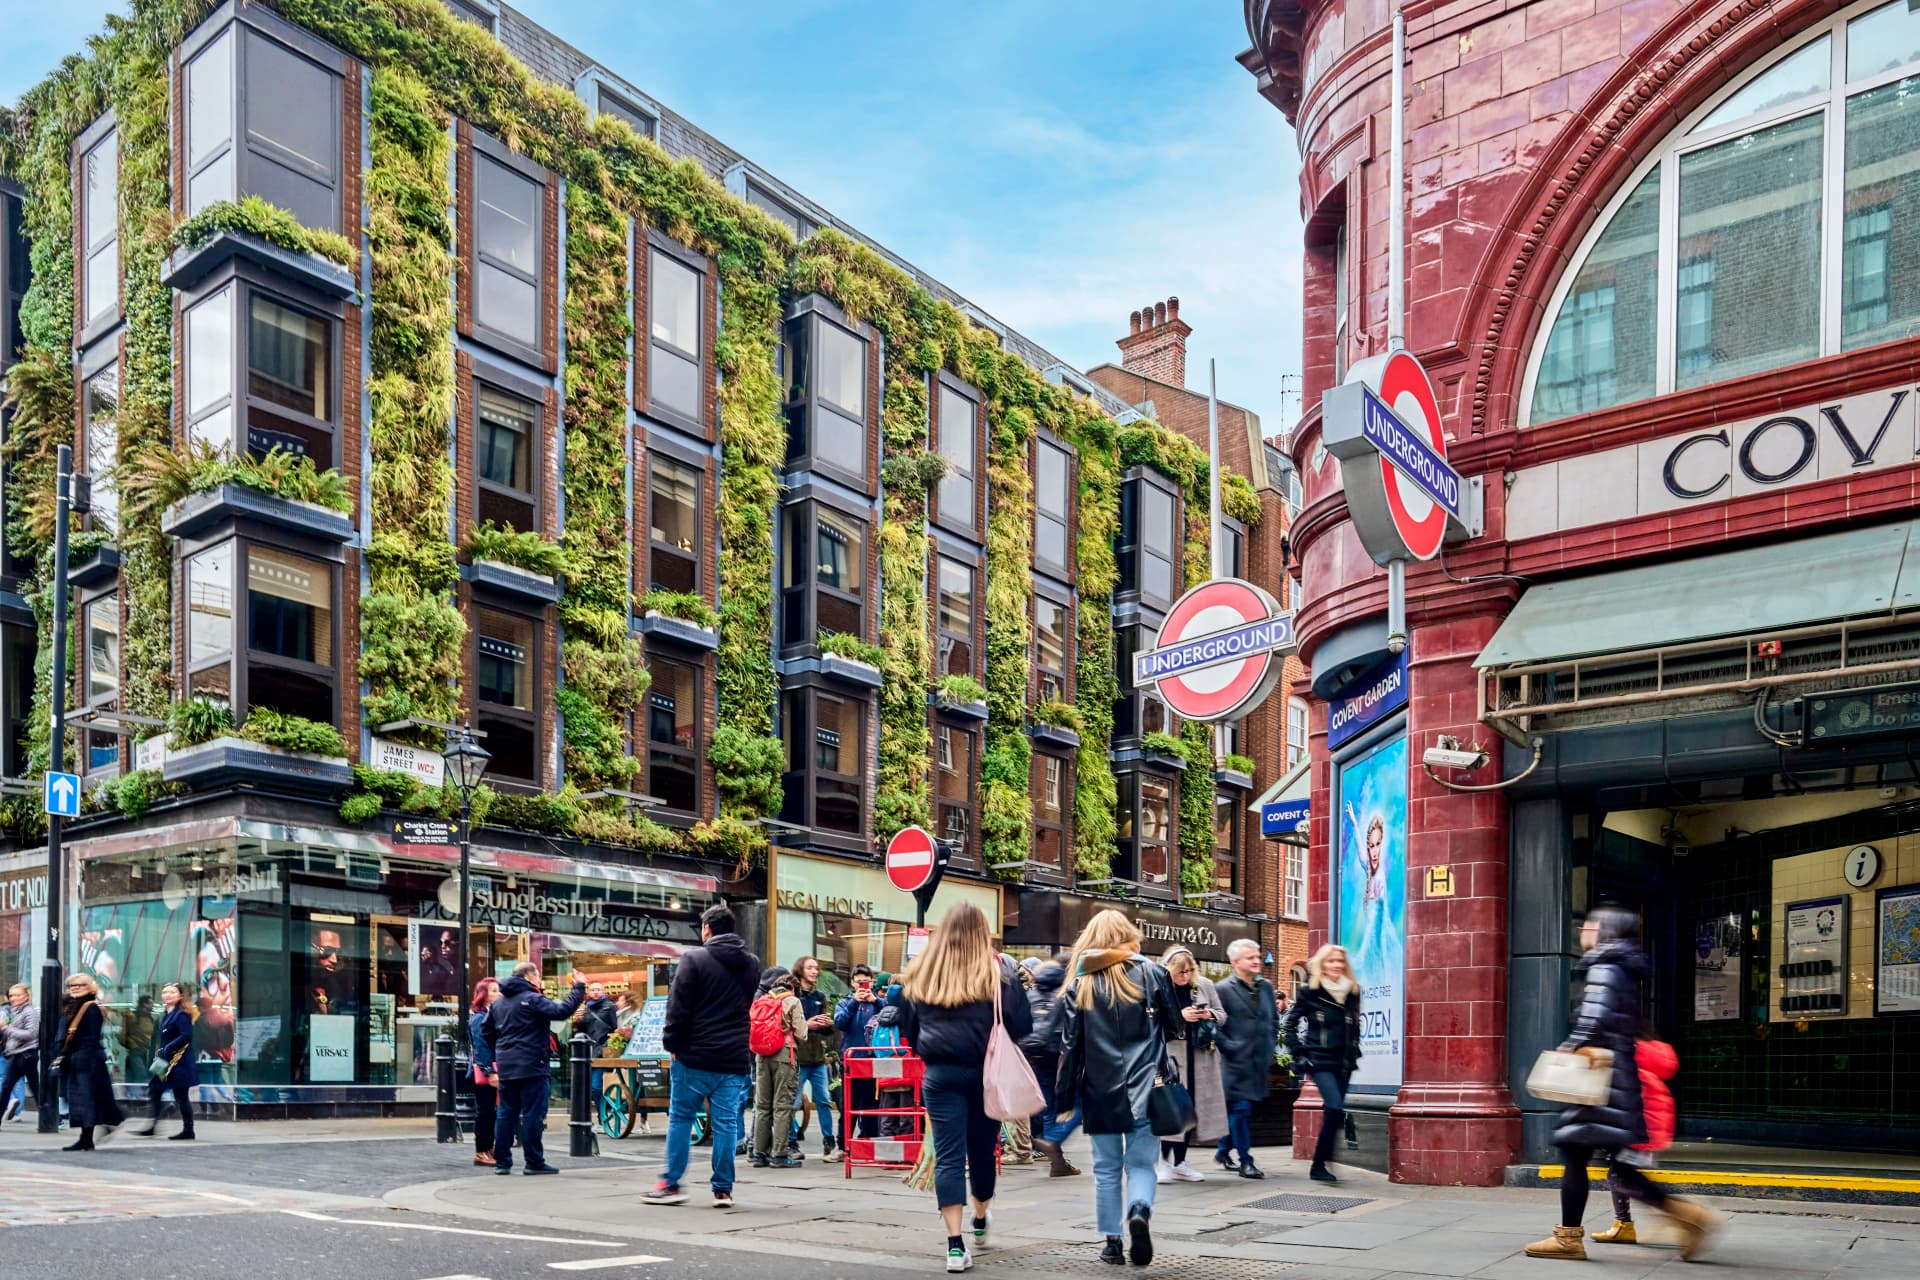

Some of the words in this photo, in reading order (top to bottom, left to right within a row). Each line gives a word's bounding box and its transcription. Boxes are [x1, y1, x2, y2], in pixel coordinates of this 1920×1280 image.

[1364, 397, 1458, 507] UNDERGROUND
[1663, 388, 1920, 498] COV
[1141, 622, 1287, 675] UNDERGROUND
[1332, 695, 1365, 730] COVENT
[1364, 668, 1401, 708] GARDEN
[1878, 692, 1920, 706] Emer
[383, 744, 415, 760] JAMES
[383, 755, 414, 769] STREET
[417, 762, 436, 774] WC2
[403, 822, 428, 831] Charing
[1267, 810, 1302, 822] COVENT
[10, 879, 25, 910] OF
[776, 888, 820, 912] REGAL
[826, 896, 874, 917] HOUSE
[1380, 984, 1392, 998] FREE
[1359, 1008, 1391, 1039] OZEN
[315, 1047, 350, 1058] VERSACE
